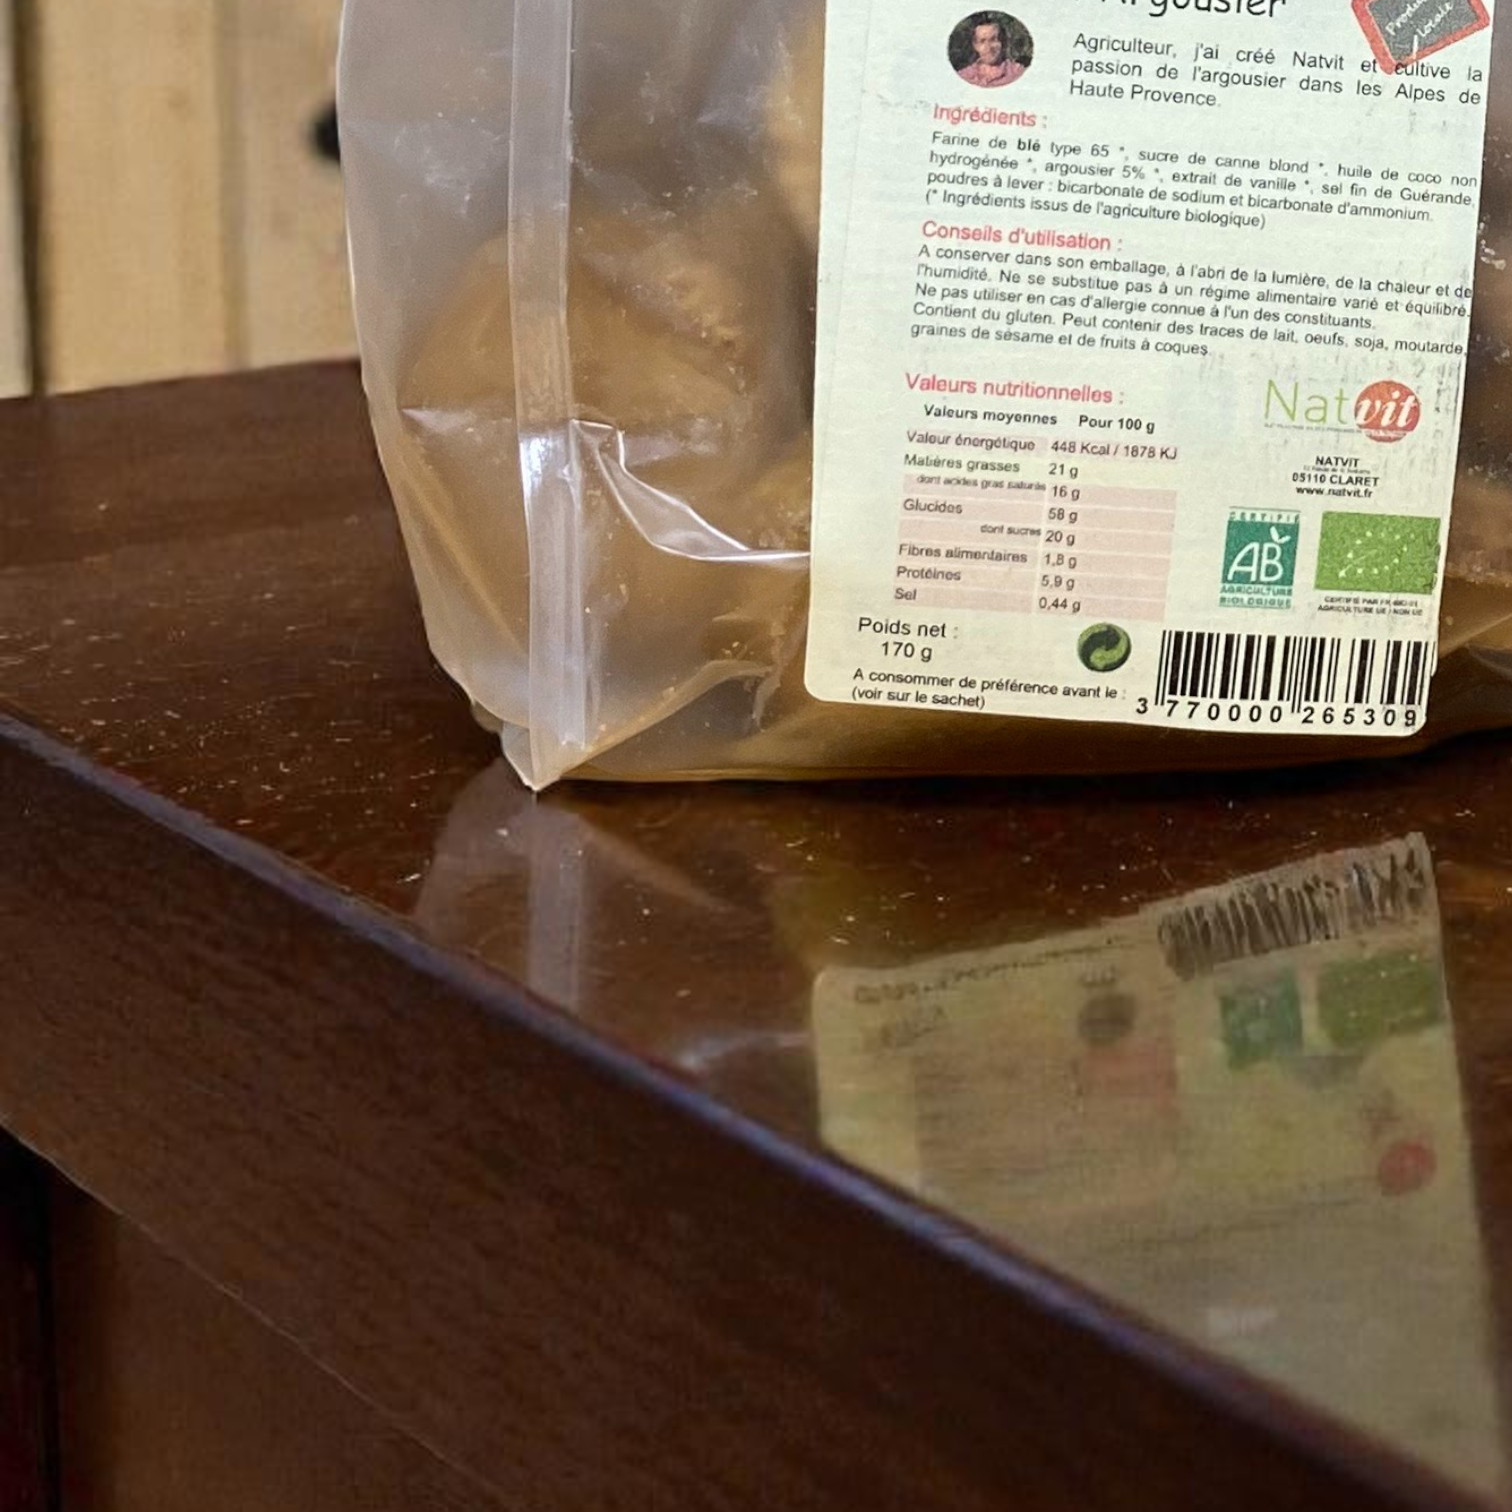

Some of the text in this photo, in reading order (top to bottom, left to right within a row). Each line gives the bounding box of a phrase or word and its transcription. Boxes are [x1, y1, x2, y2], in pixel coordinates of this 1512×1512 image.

[1074, 33, 1482, 82] Agriculteur, j'ai créé Natvit et cultive la
[1070, 80, 1221, 107] Haute Provence.
[1072, 58, 1481, 104] passion de l'argousier dans les Alpes de
[933, 103, 1036, 128] Ingrédients
[932, 131, 1477, 188] Farine blé 65 blond huile coco non
[930, 150, 1475, 209] hydrogénée 5% vanille sel Guérande,
[927, 170, 1433, 222] poudres bicarbonate sodium bicarbonate d'ammonium.
[943, 190, 1266, 230] Ingrédients l'agriculture biologique)
[922, 220, 1111, 250] Conseils d'utilisation
[916, 263, 1471, 318] l'humidité. régime alimentaire équilibré.
[1272, 270, 1430, 295] lumière, chaleur
[913, 302, 1467, 356] Contient gluten. lait, oeufs, soja, moutarde,
[1224, 304, 1375, 330] l'un constituants.
[995, 328, 1212, 357] sésame coques.
[906, 372, 1112, 404] Valeurs nutritionnelles
[924, 404, 1142, 430] Valeurs moyennes Pour 100
[906, 430, 1177, 460] Valeur énergétique 448 Kcal 1878 KJ
[904, 454, 1066, 475] Matières grasses 21
[1315, 456, 1360, 468] NATVIT
[1052, 485, 1068, 498] 16
[1296, 486, 1373, 498] www.natvit.fr
[1330, 474, 1379, 487] CLARET
[904, 498, 1066, 520] Glucides 58
[1045, 530, 1063, 543] 20
[899, 544, 1064, 566] Fibres alimentaires 1,8
[1227, 542, 1283, 581] AB
[896, 566, 1062, 587] Protéines 5,9
[894, 588, 1068, 610] Sel 0,44
[858, 617, 946, 638] Poids net
[882, 641, 932, 662] 170 g
[853, 668, 1117, 699] A consommer de préférence avant le
[852, 686, 986, 710] (voir sur le sachet)
